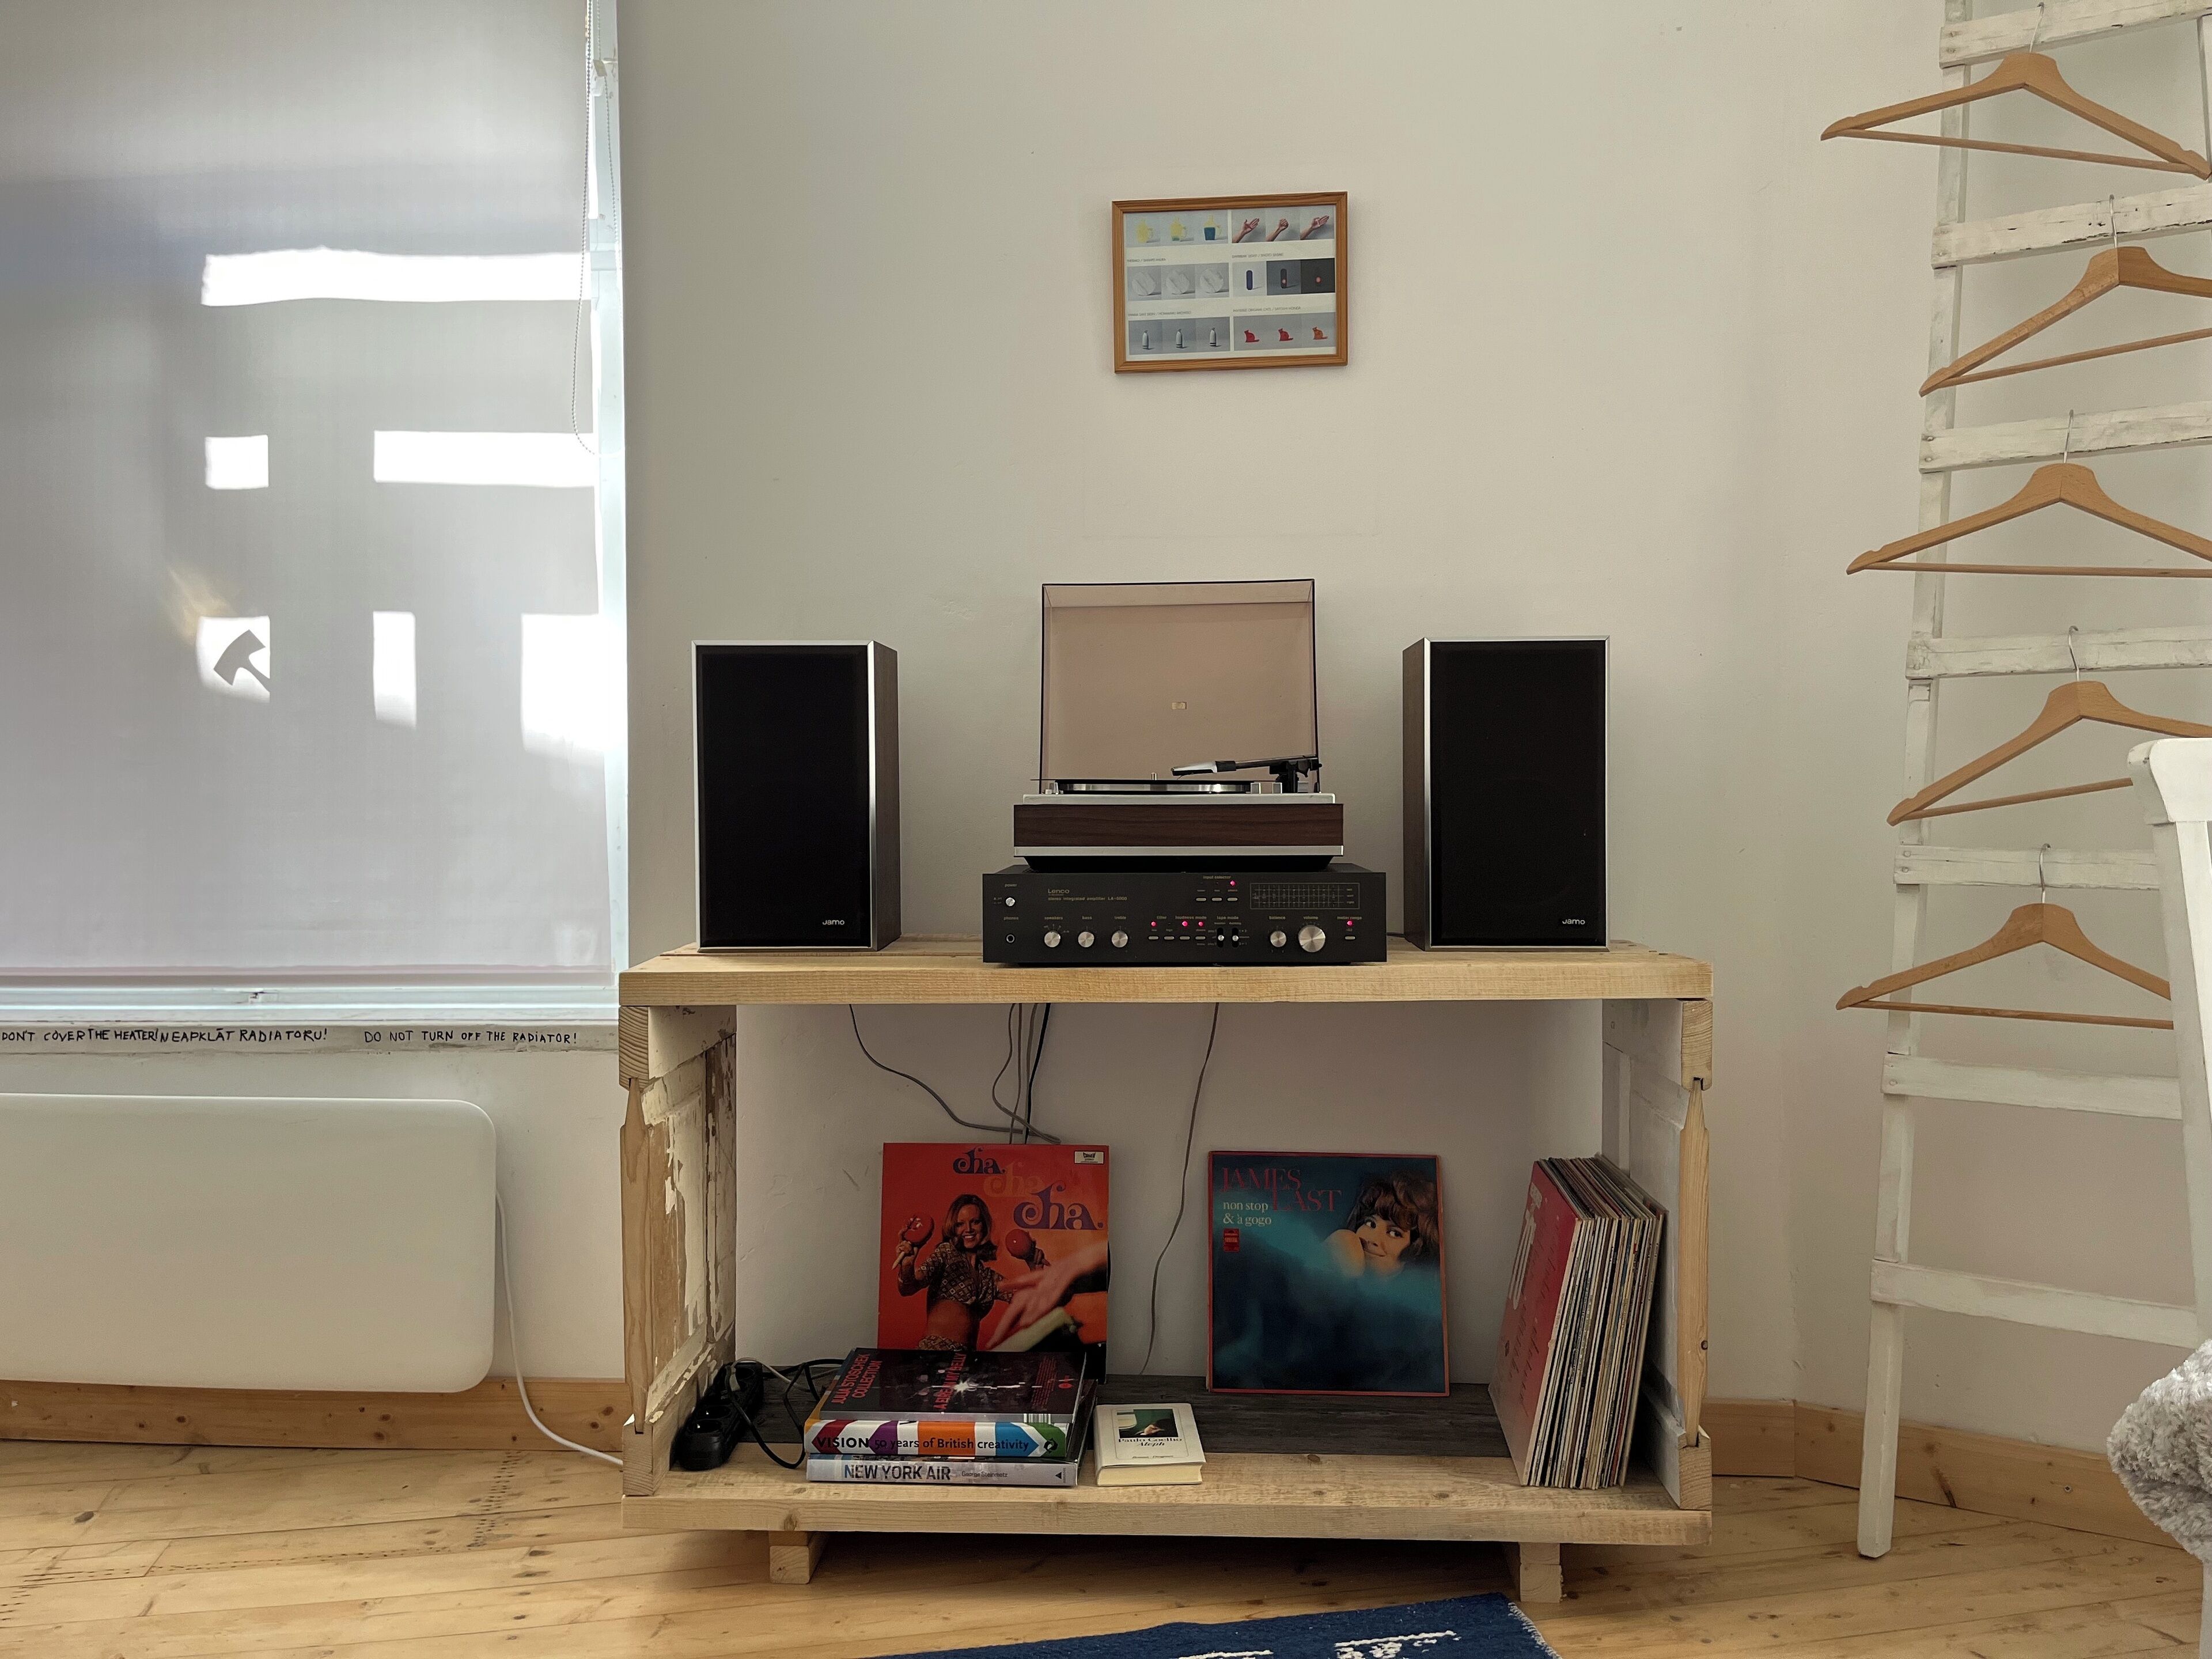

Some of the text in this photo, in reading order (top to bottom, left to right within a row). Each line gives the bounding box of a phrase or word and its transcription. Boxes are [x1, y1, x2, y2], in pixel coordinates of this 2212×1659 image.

[2, 1030, 35, 1041] DON'T
[44, 1030, 86, 1042] COVER
[88, 1028, 111, 1040] THE
[160, 1028, 235, 1042] NEAPKLĀT
[364, 1031, 381, 1043] DO
[390, 1031, 414, 1041] NOT
[422, 1031, 453, 1041] TURN
[461, 1032, 482, 1040] OFF
[486, 1031, 506, 1041] THE
[1220, 1168, 1302, 1194] JAMES
[1223, 1202, 1268, 1213] non stop
[1272, 1190, 1342, 1212] LAST
[1223, 1213, 1234, 1224] &
[1245, 1215, 1272, 1227] gogo
[949, 1353, 967, 1371] BELLY
[851, 1361, 883, 1399] COLLECTION
[831, 1387, 853, 1404] JULIA
[816, 1437, 1029, 1452] VISION 50 years of British creativity
[844, 1464, 950, 1480] NEW YORK AIR
[961, 1471, 981, 1479] George
